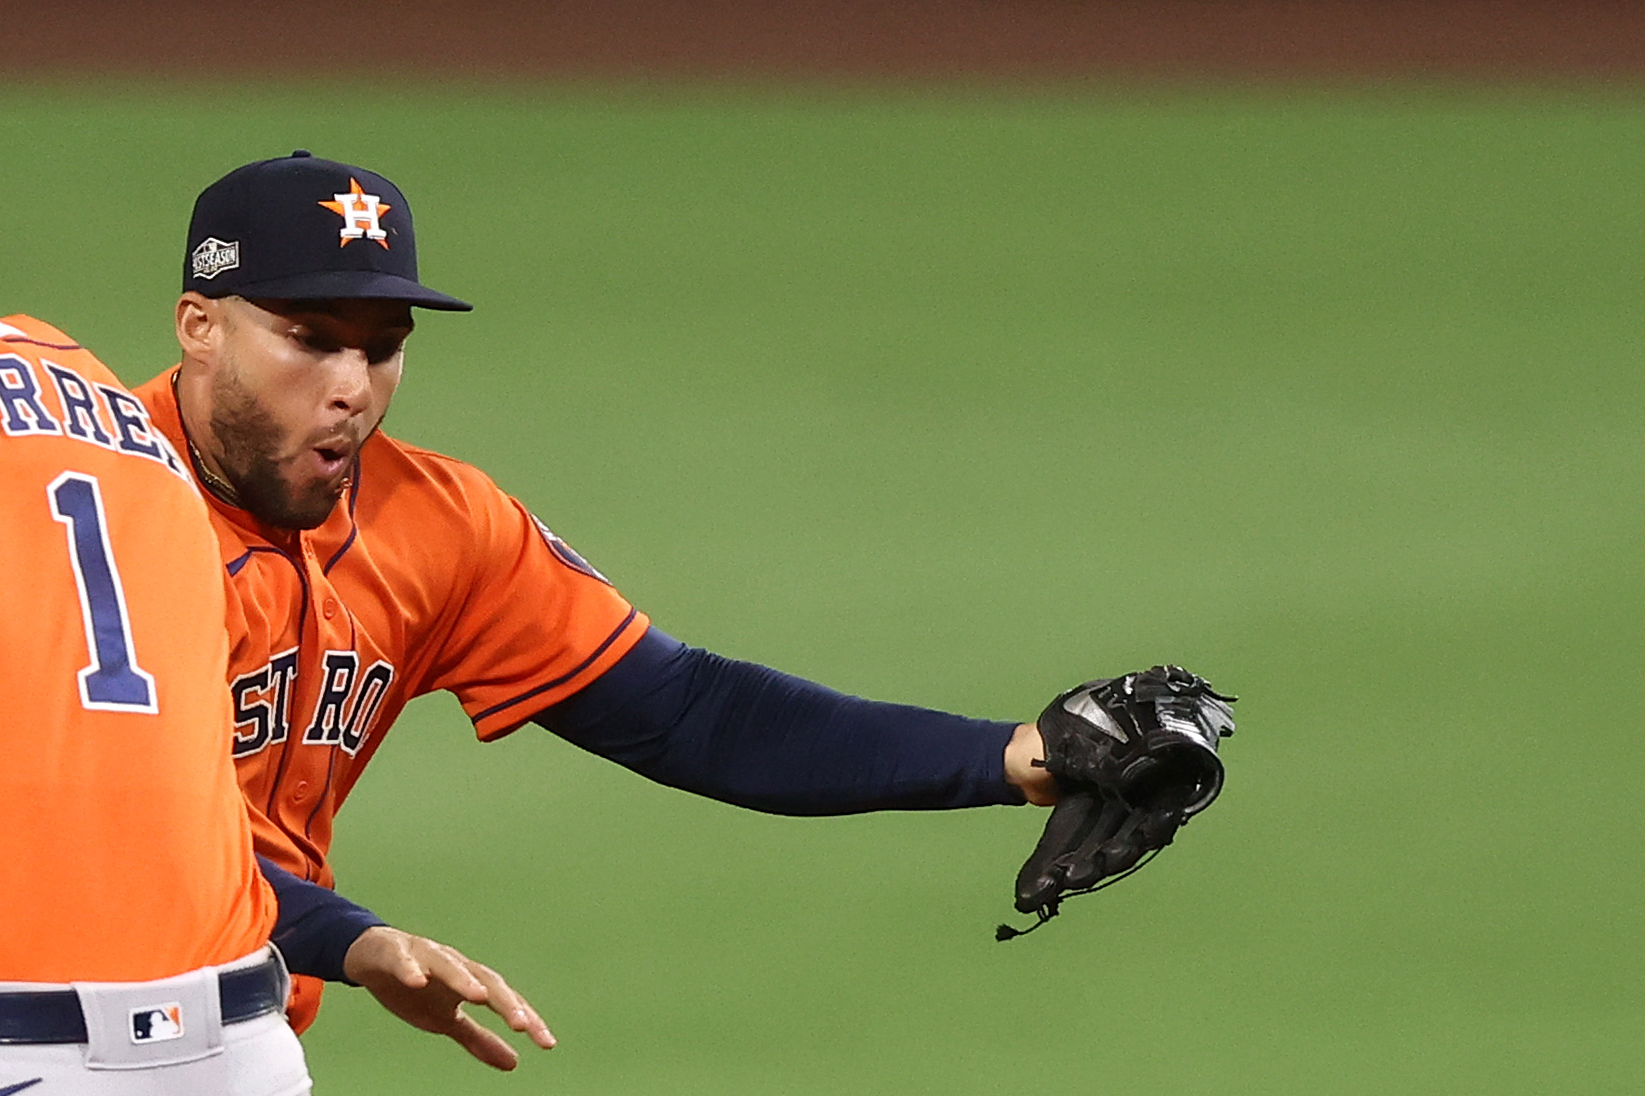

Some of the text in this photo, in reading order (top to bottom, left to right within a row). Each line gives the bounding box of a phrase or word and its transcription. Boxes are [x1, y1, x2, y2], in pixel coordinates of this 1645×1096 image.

[334, 193, 387, 239] H
[46, 470, 159, 714] 1
[230, 646, 395, 759] STRO
